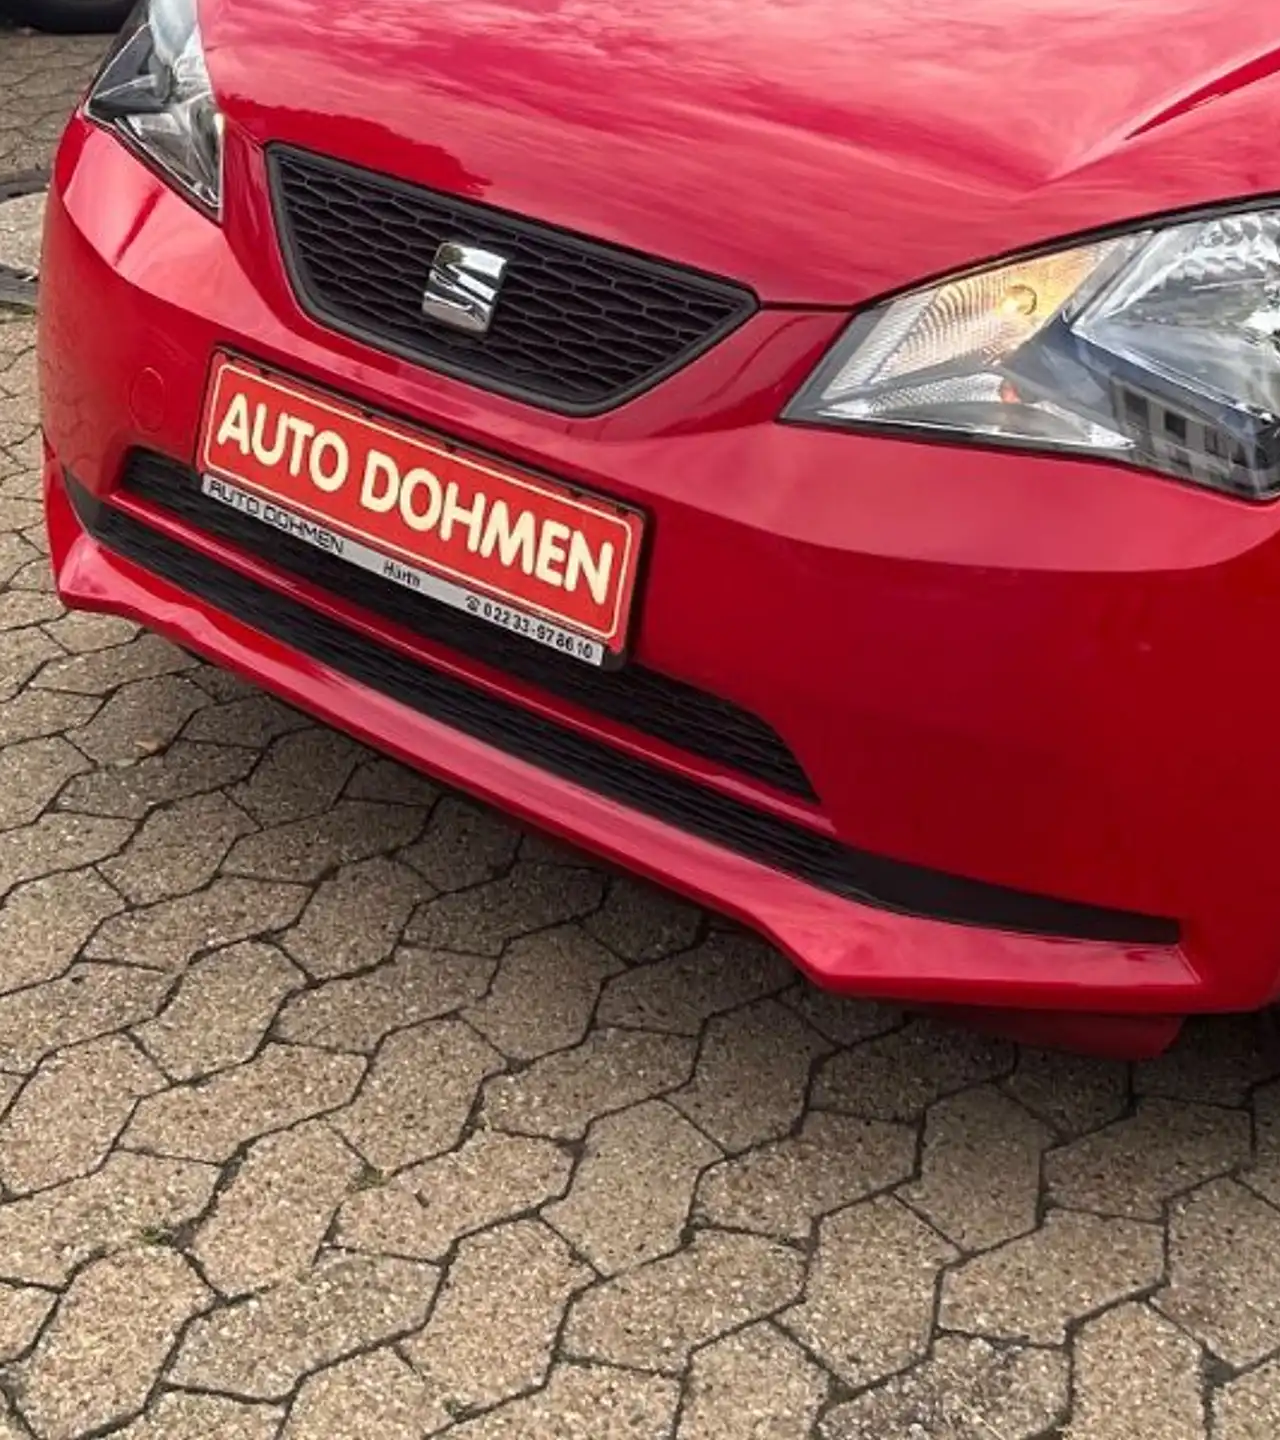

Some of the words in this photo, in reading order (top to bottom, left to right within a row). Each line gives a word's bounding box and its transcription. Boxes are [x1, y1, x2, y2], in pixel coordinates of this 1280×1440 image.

[208, 478, 260, 515] AUTO
[264, 504, 345, 555] DOHMEN
[216, 391, 349, 493] AUTO
[358, 450, 615, 606] DOHMEN
